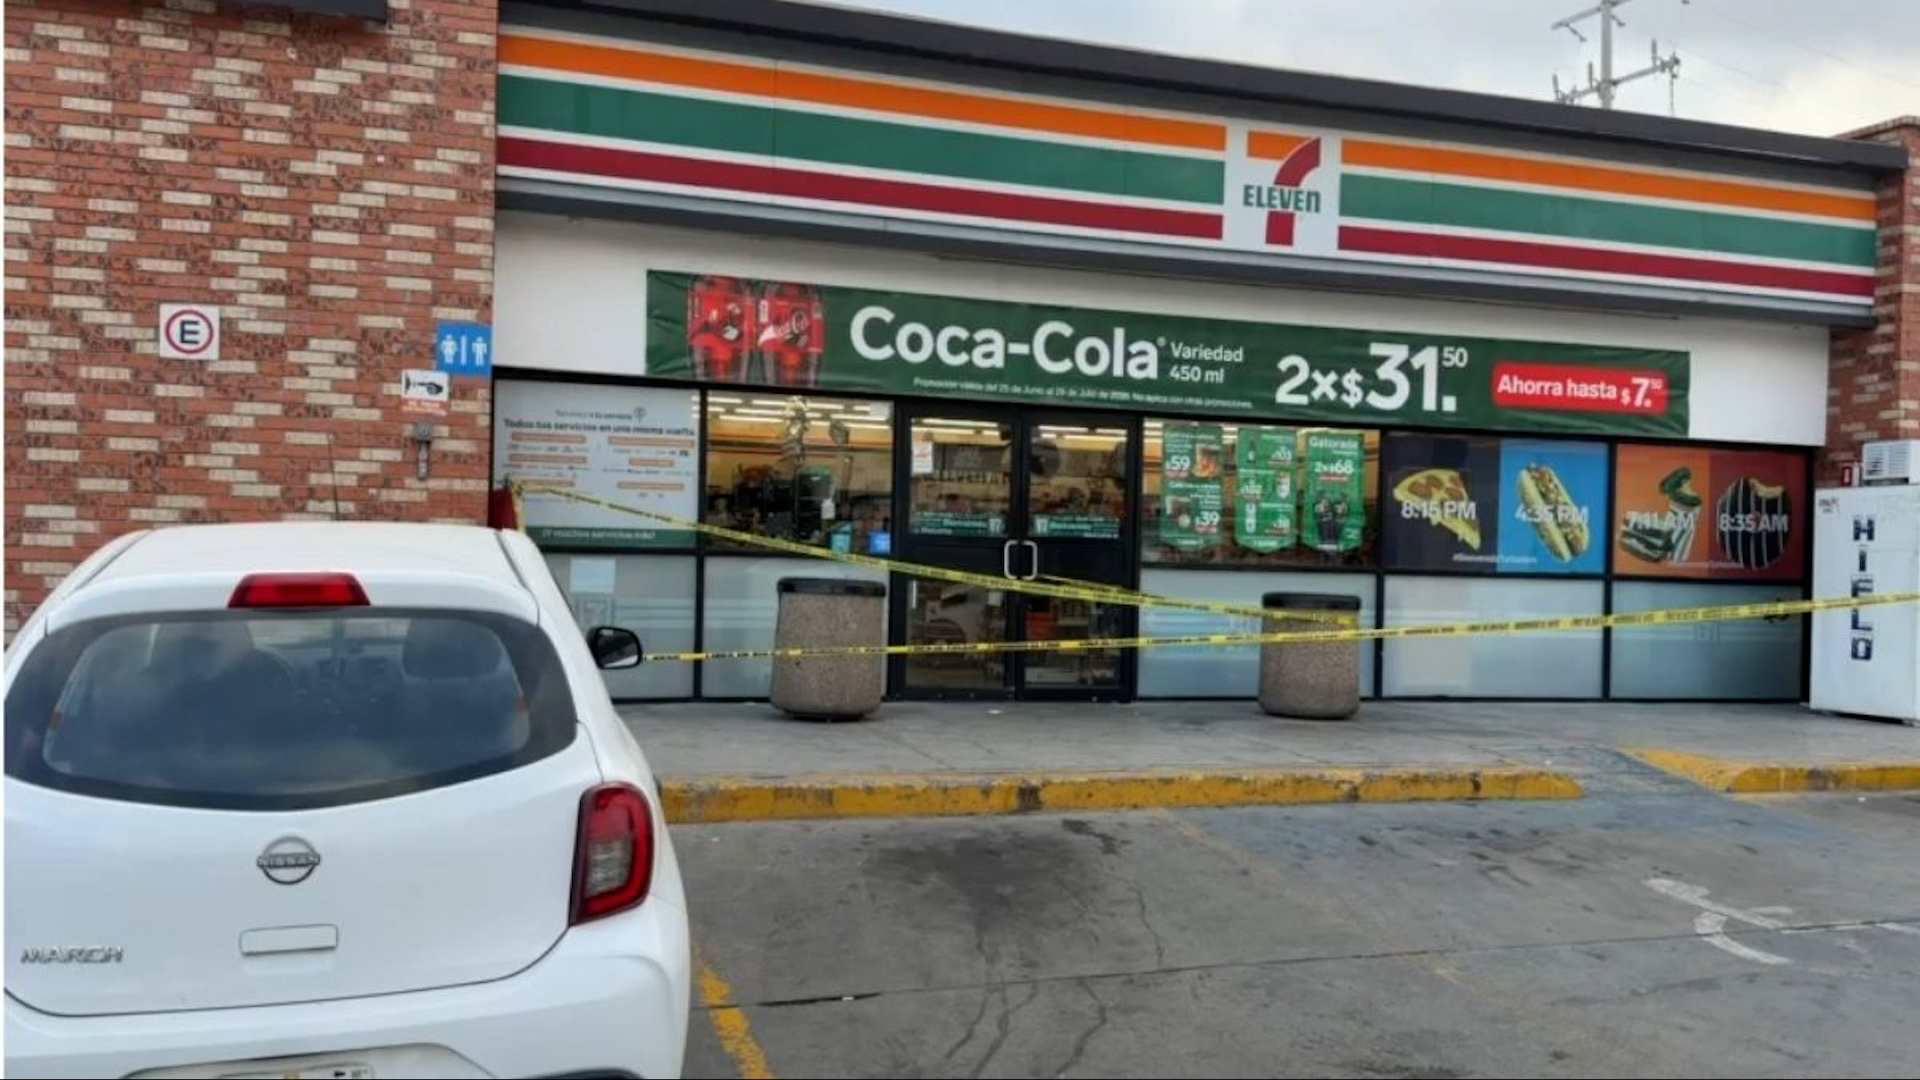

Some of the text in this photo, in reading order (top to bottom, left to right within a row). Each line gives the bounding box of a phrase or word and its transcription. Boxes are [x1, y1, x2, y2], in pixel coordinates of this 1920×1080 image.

[180, 320, 200, 344] E
[1170, 341, 1243, 362] Variedad
[1169, 364, 1225, 384] 450 ml
[1498, 374, 1563, 396] Ahorra
[1566, 379, 1617, 400] hasta
[504, 418, 534, 428] Todos
[536, 419, 551, 429] tus
[554, 421, 597, 432] servicios
[1402, 500, 1477, 520] 8:15 PM
[1558, 506, 1590, 525] PM
[1663, 512, 1694, 531] AM
[1719, 513, 1789, 532] 8:35 AM
[1851, 517, 1875, 661] HIELO
[258, 853, 320, 868] NISSAN
[20, 946, 123, 964] MARCH
